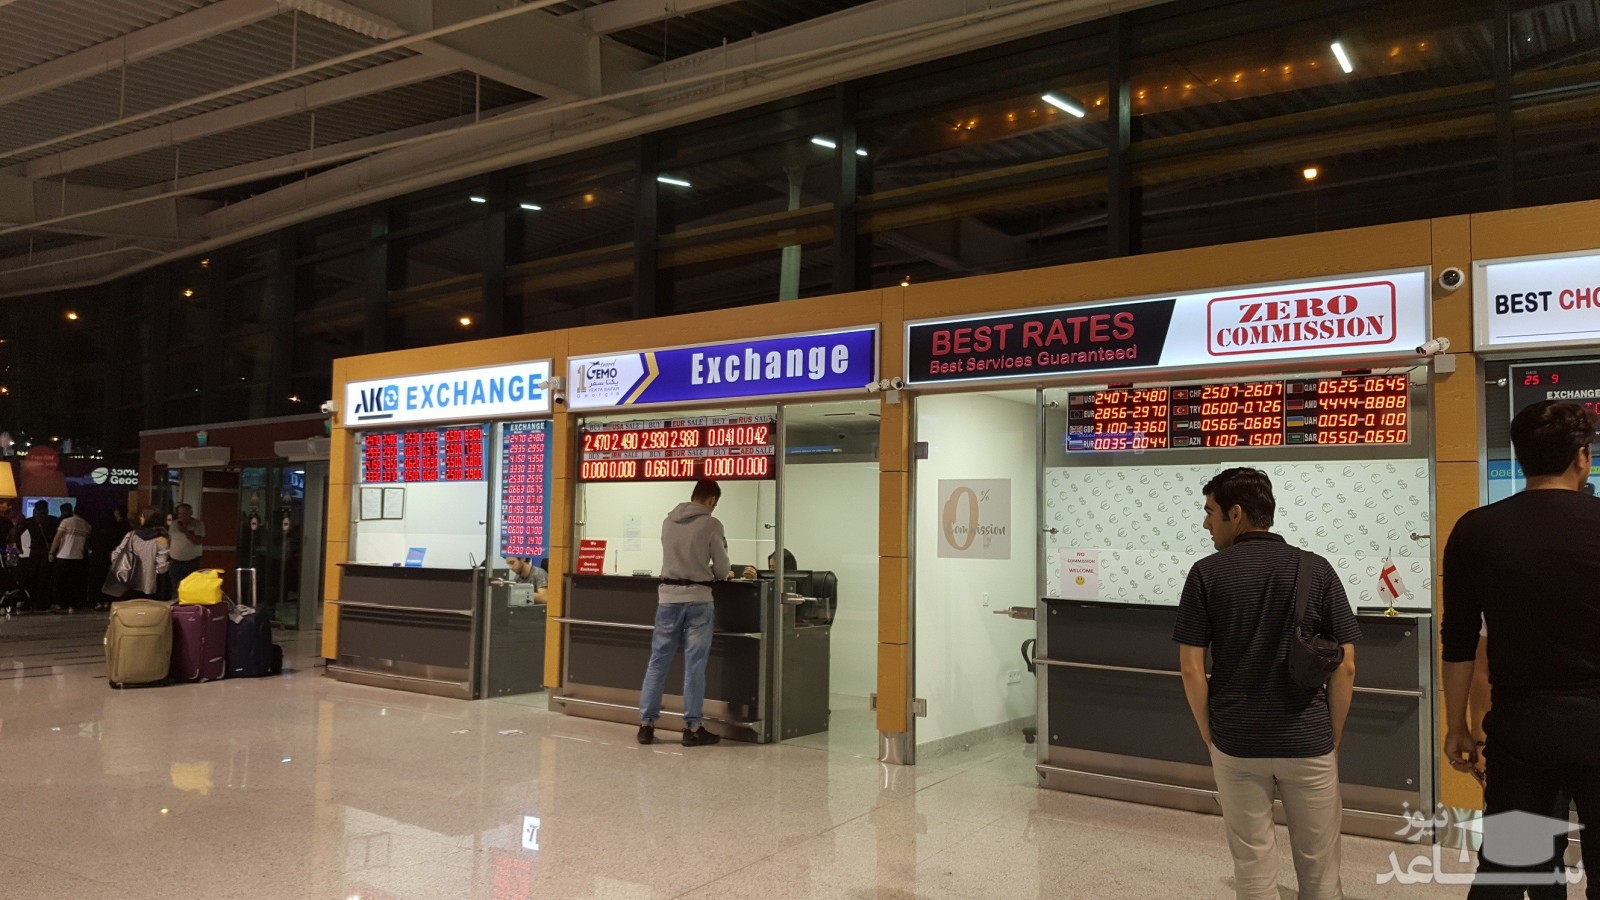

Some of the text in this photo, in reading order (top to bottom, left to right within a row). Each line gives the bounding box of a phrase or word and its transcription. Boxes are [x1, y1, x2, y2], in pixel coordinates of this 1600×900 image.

[1496, 291, 1552, 314] BEST
[1239, 295, 1358, 323] ZERO
[932, 312, 1135, 355] BEST RATES
[1216, 315, 1385, 347] COMMISSION
[930, 344, 1136, 374] Best Services Guaranteed
[691, 345, 848, 385] Exchange
[587, 365, 617, 380] GEMO
[1524, 374, 1559, 385] 25 9
[407, 374, 542, 410] EXCHANGE
[1189, 390, 1201, 398] CHF
[1546, 389, 1600, 399] EXCHANGE
[1083, 395, 1095, 403] USD
[1304, 400, 1317, 409] AMD
[1084, 410, 1094, 418] EUR
[1190, 406, 1201, 414] TRY
[625, 422, 640, 430] SALE
[648, 421, 660, 429] BUY
[687, 418, 704, 426] SALE
[738, 416, 752, 424] RUS
[1304, 417, 1317, 425] UAH
[510, 422, 545, 431] EXCHANGE
[1083, 425, 1094, 433] GBP
[584, 426, 767, 451] 2.470 2.490 2.930 2.980 0.041 0.042
[1189, 437, 1201, 445] AZN
[1304, 433, 1317, 442] SAR
[740, 447, 754, 455] AED
[755, 446, 773, 454] SALE
[582, 462, 608, 478] 0.000
[609, 461, 636, 478] 0.000
[645, 460, 669, 477] 0.661
[704, 458, 734, 476] 0.000
[736, 457, 767, 476] 0.000
